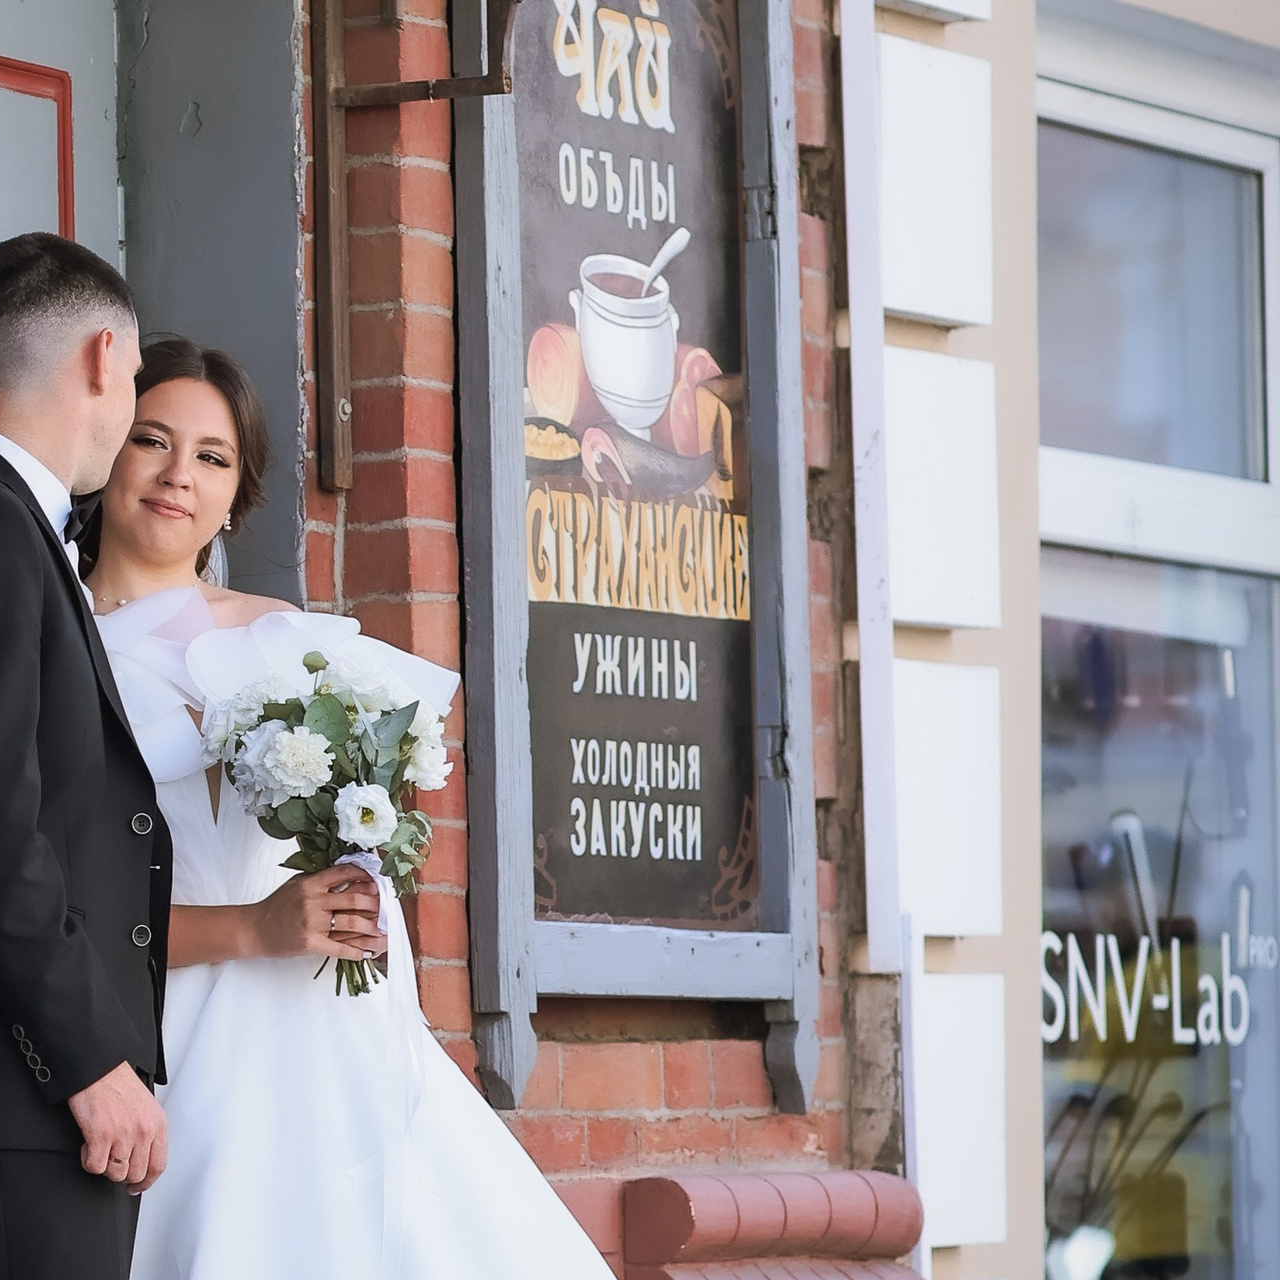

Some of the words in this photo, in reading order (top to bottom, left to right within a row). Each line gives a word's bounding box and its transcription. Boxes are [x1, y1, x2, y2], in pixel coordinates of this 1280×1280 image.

[558, 142, 677, 231] ОБЪДЫ
[572, 632, 698, 702] УЖИНЫ
[570, 737, 702, 797] ХОЛОДНЫЯ
[570, 796, 703, 862] ЗАКУСКИ
[1041, 930, 1250, 1047] SNV-Lab
